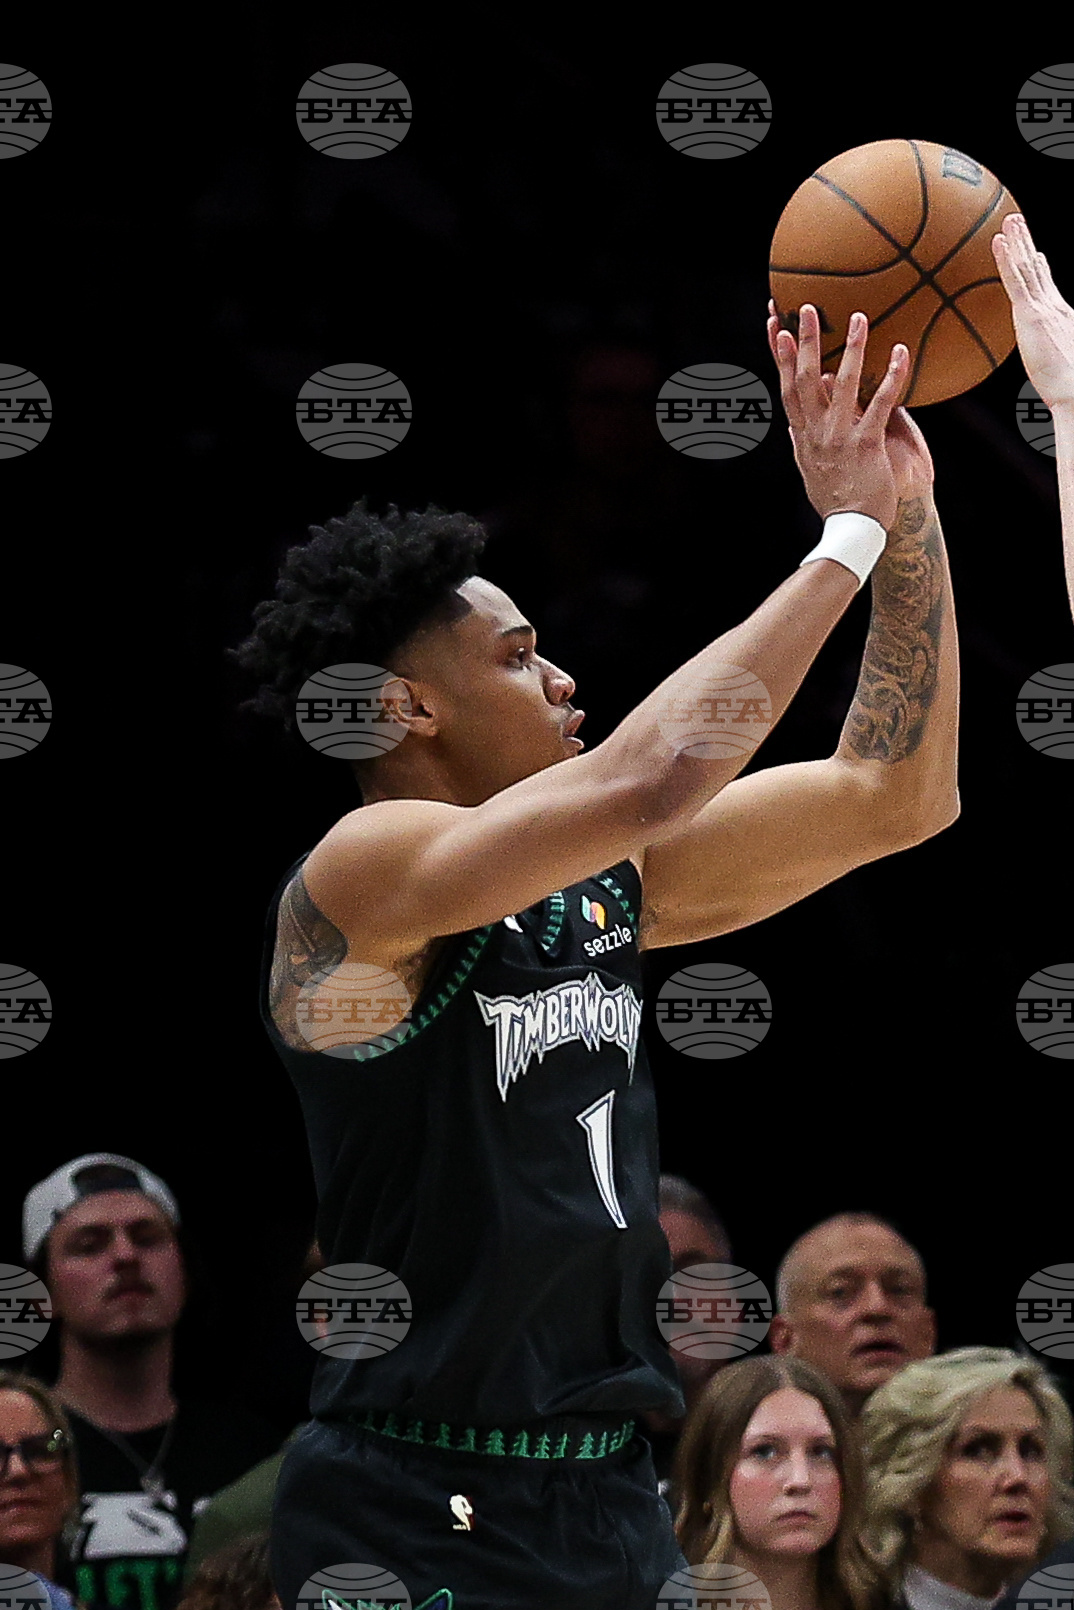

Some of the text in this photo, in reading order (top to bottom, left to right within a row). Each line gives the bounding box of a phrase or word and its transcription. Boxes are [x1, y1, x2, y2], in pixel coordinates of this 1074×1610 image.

[583, 922, 633, 957] sezzle
[473, 971, 644, 1103] TIMBERWOLV
[576, 1089, 628, 1230] 1
